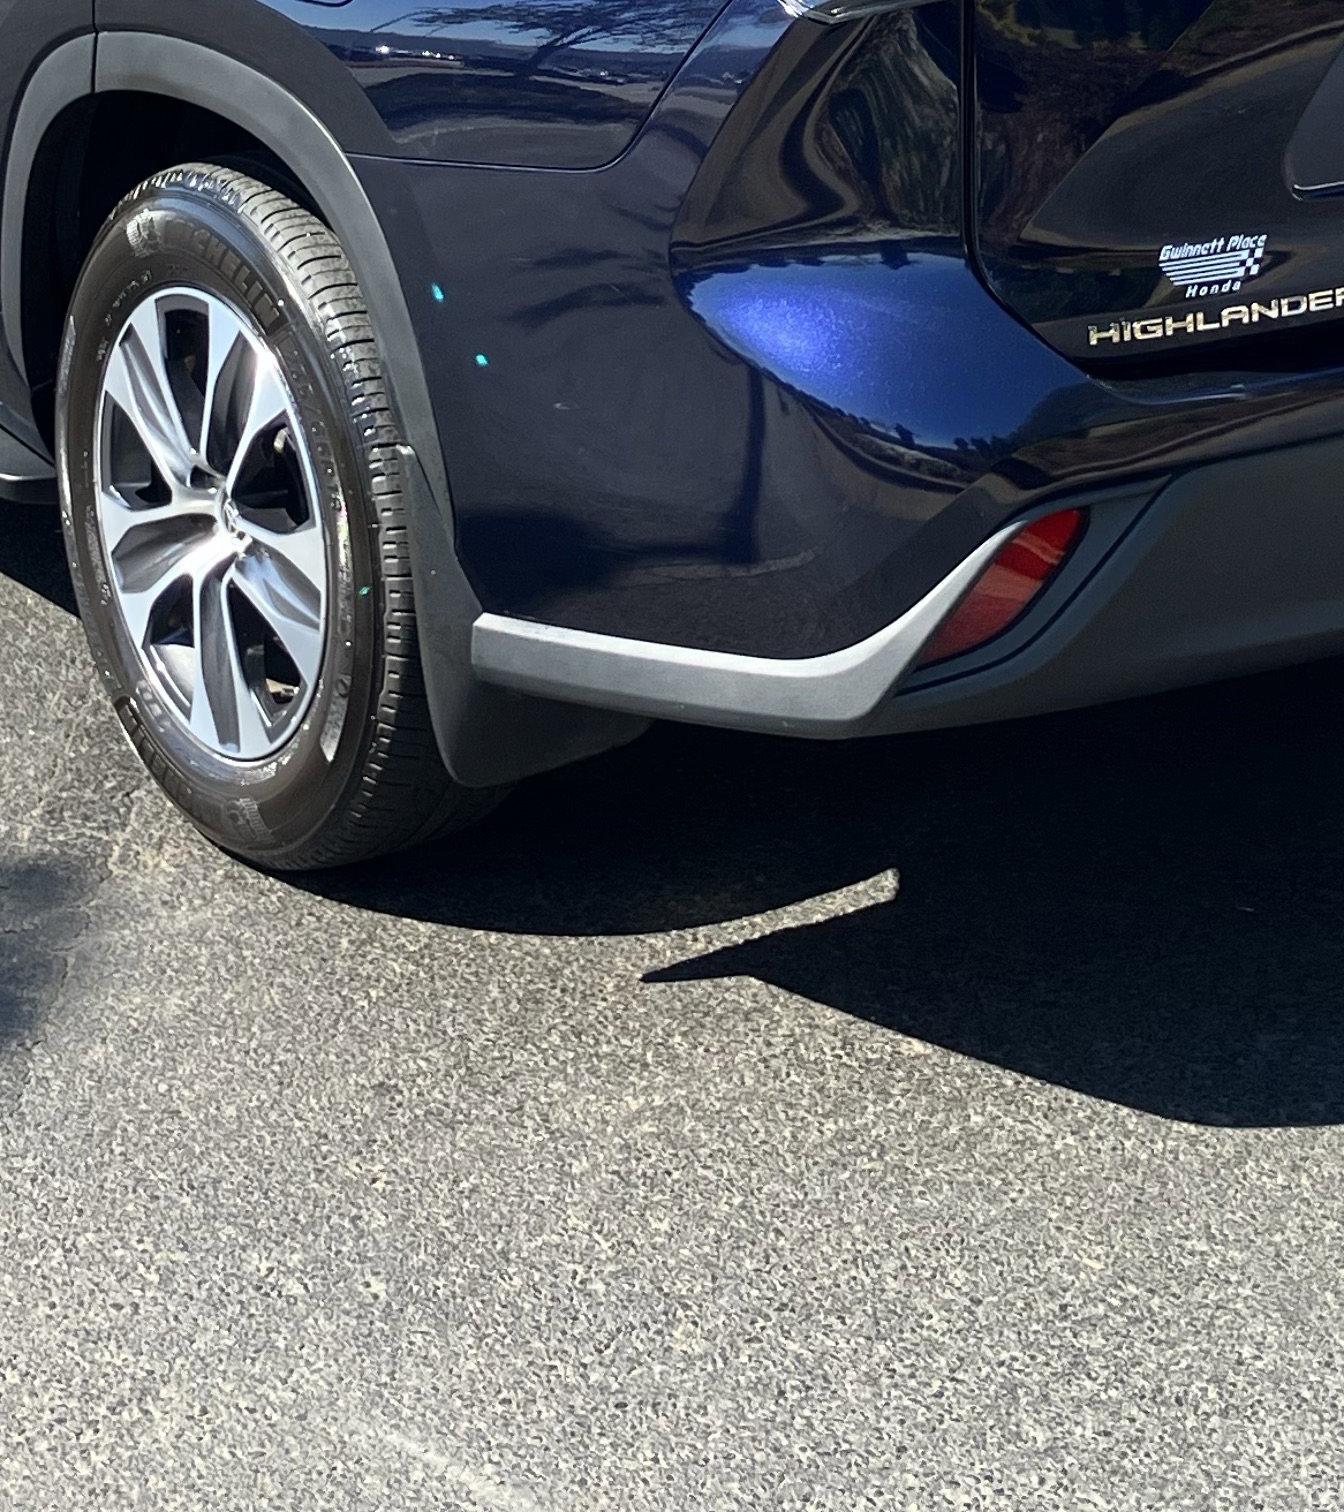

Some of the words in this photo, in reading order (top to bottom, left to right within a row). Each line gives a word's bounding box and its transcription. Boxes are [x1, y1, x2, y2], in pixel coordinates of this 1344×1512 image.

[1159, 238, 1225, 261] Gwinnett
[1226, 234, 1267, 252] Place
[1185, 279, 1241, 299] Honda
